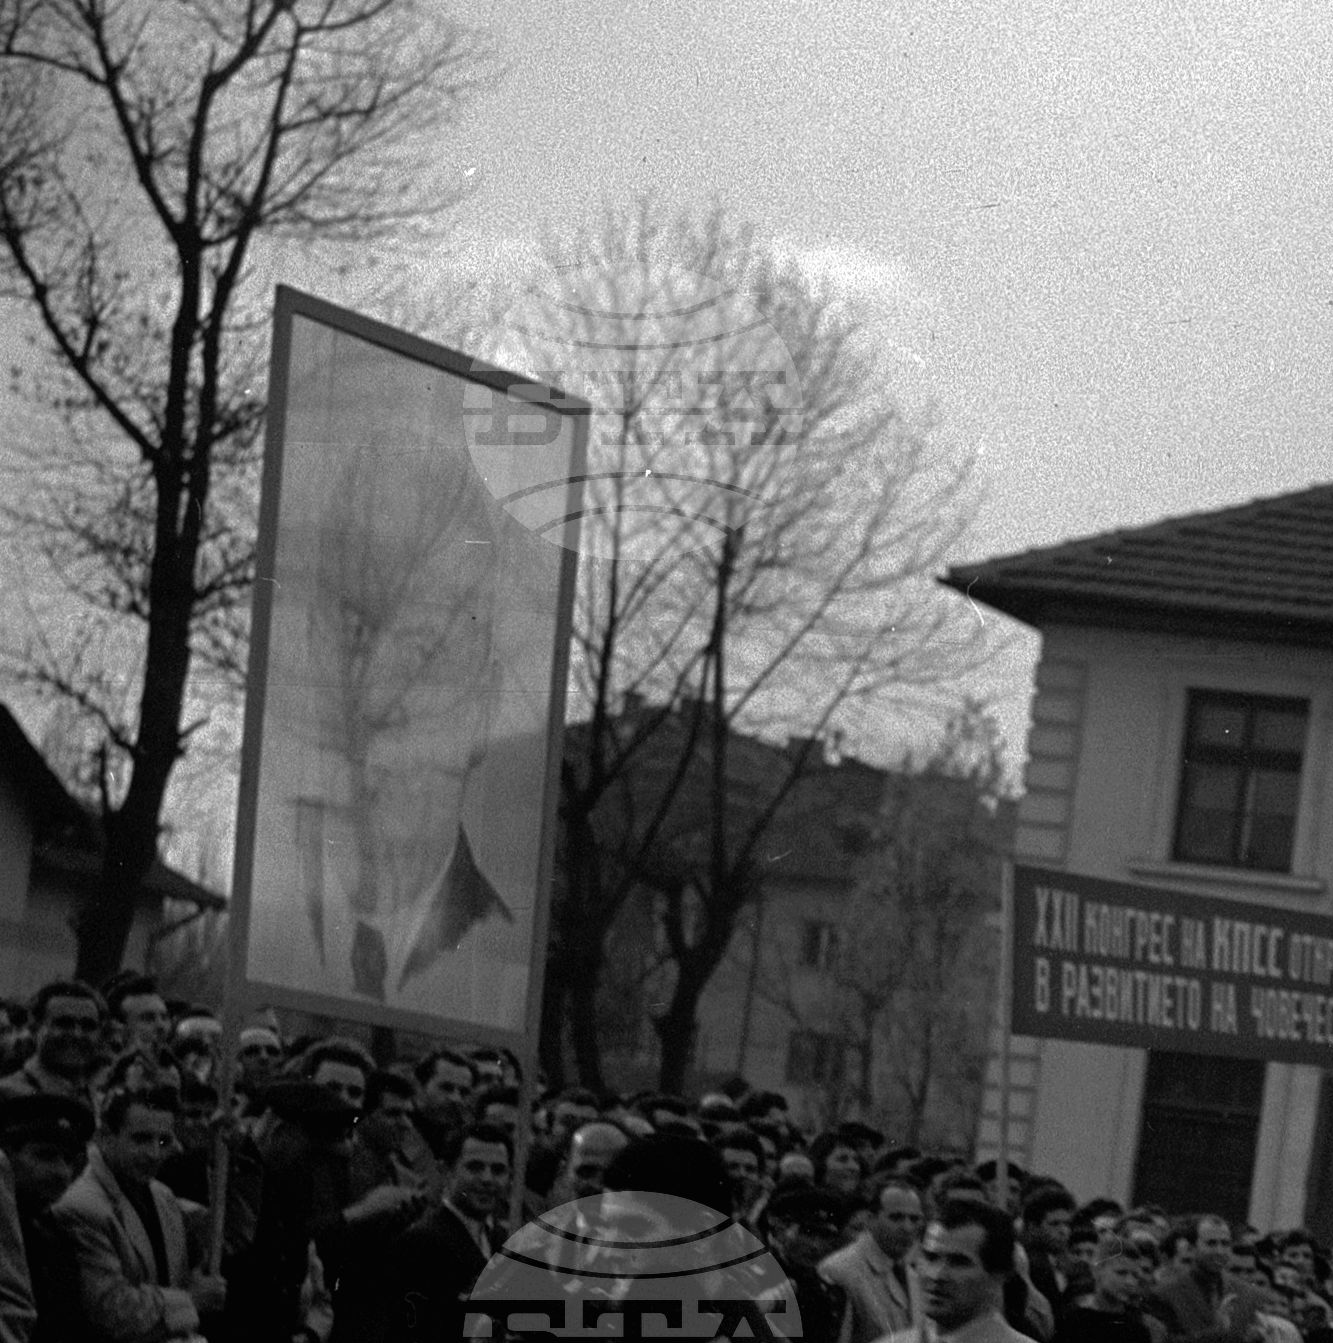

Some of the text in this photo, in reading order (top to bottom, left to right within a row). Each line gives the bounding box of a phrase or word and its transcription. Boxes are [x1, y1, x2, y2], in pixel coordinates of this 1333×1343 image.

[1083, 901, 1175, 965] КОНГРЕС
[1180, 916, 1206, 969] НА
[1212, 916, 1284, 977] КПСС
[1035, 957, 1050, 1013] В
[1061, 961, 1201, 1031] РАЗВИТИЕТО
[1210, 982, 1238, 1035] НА
